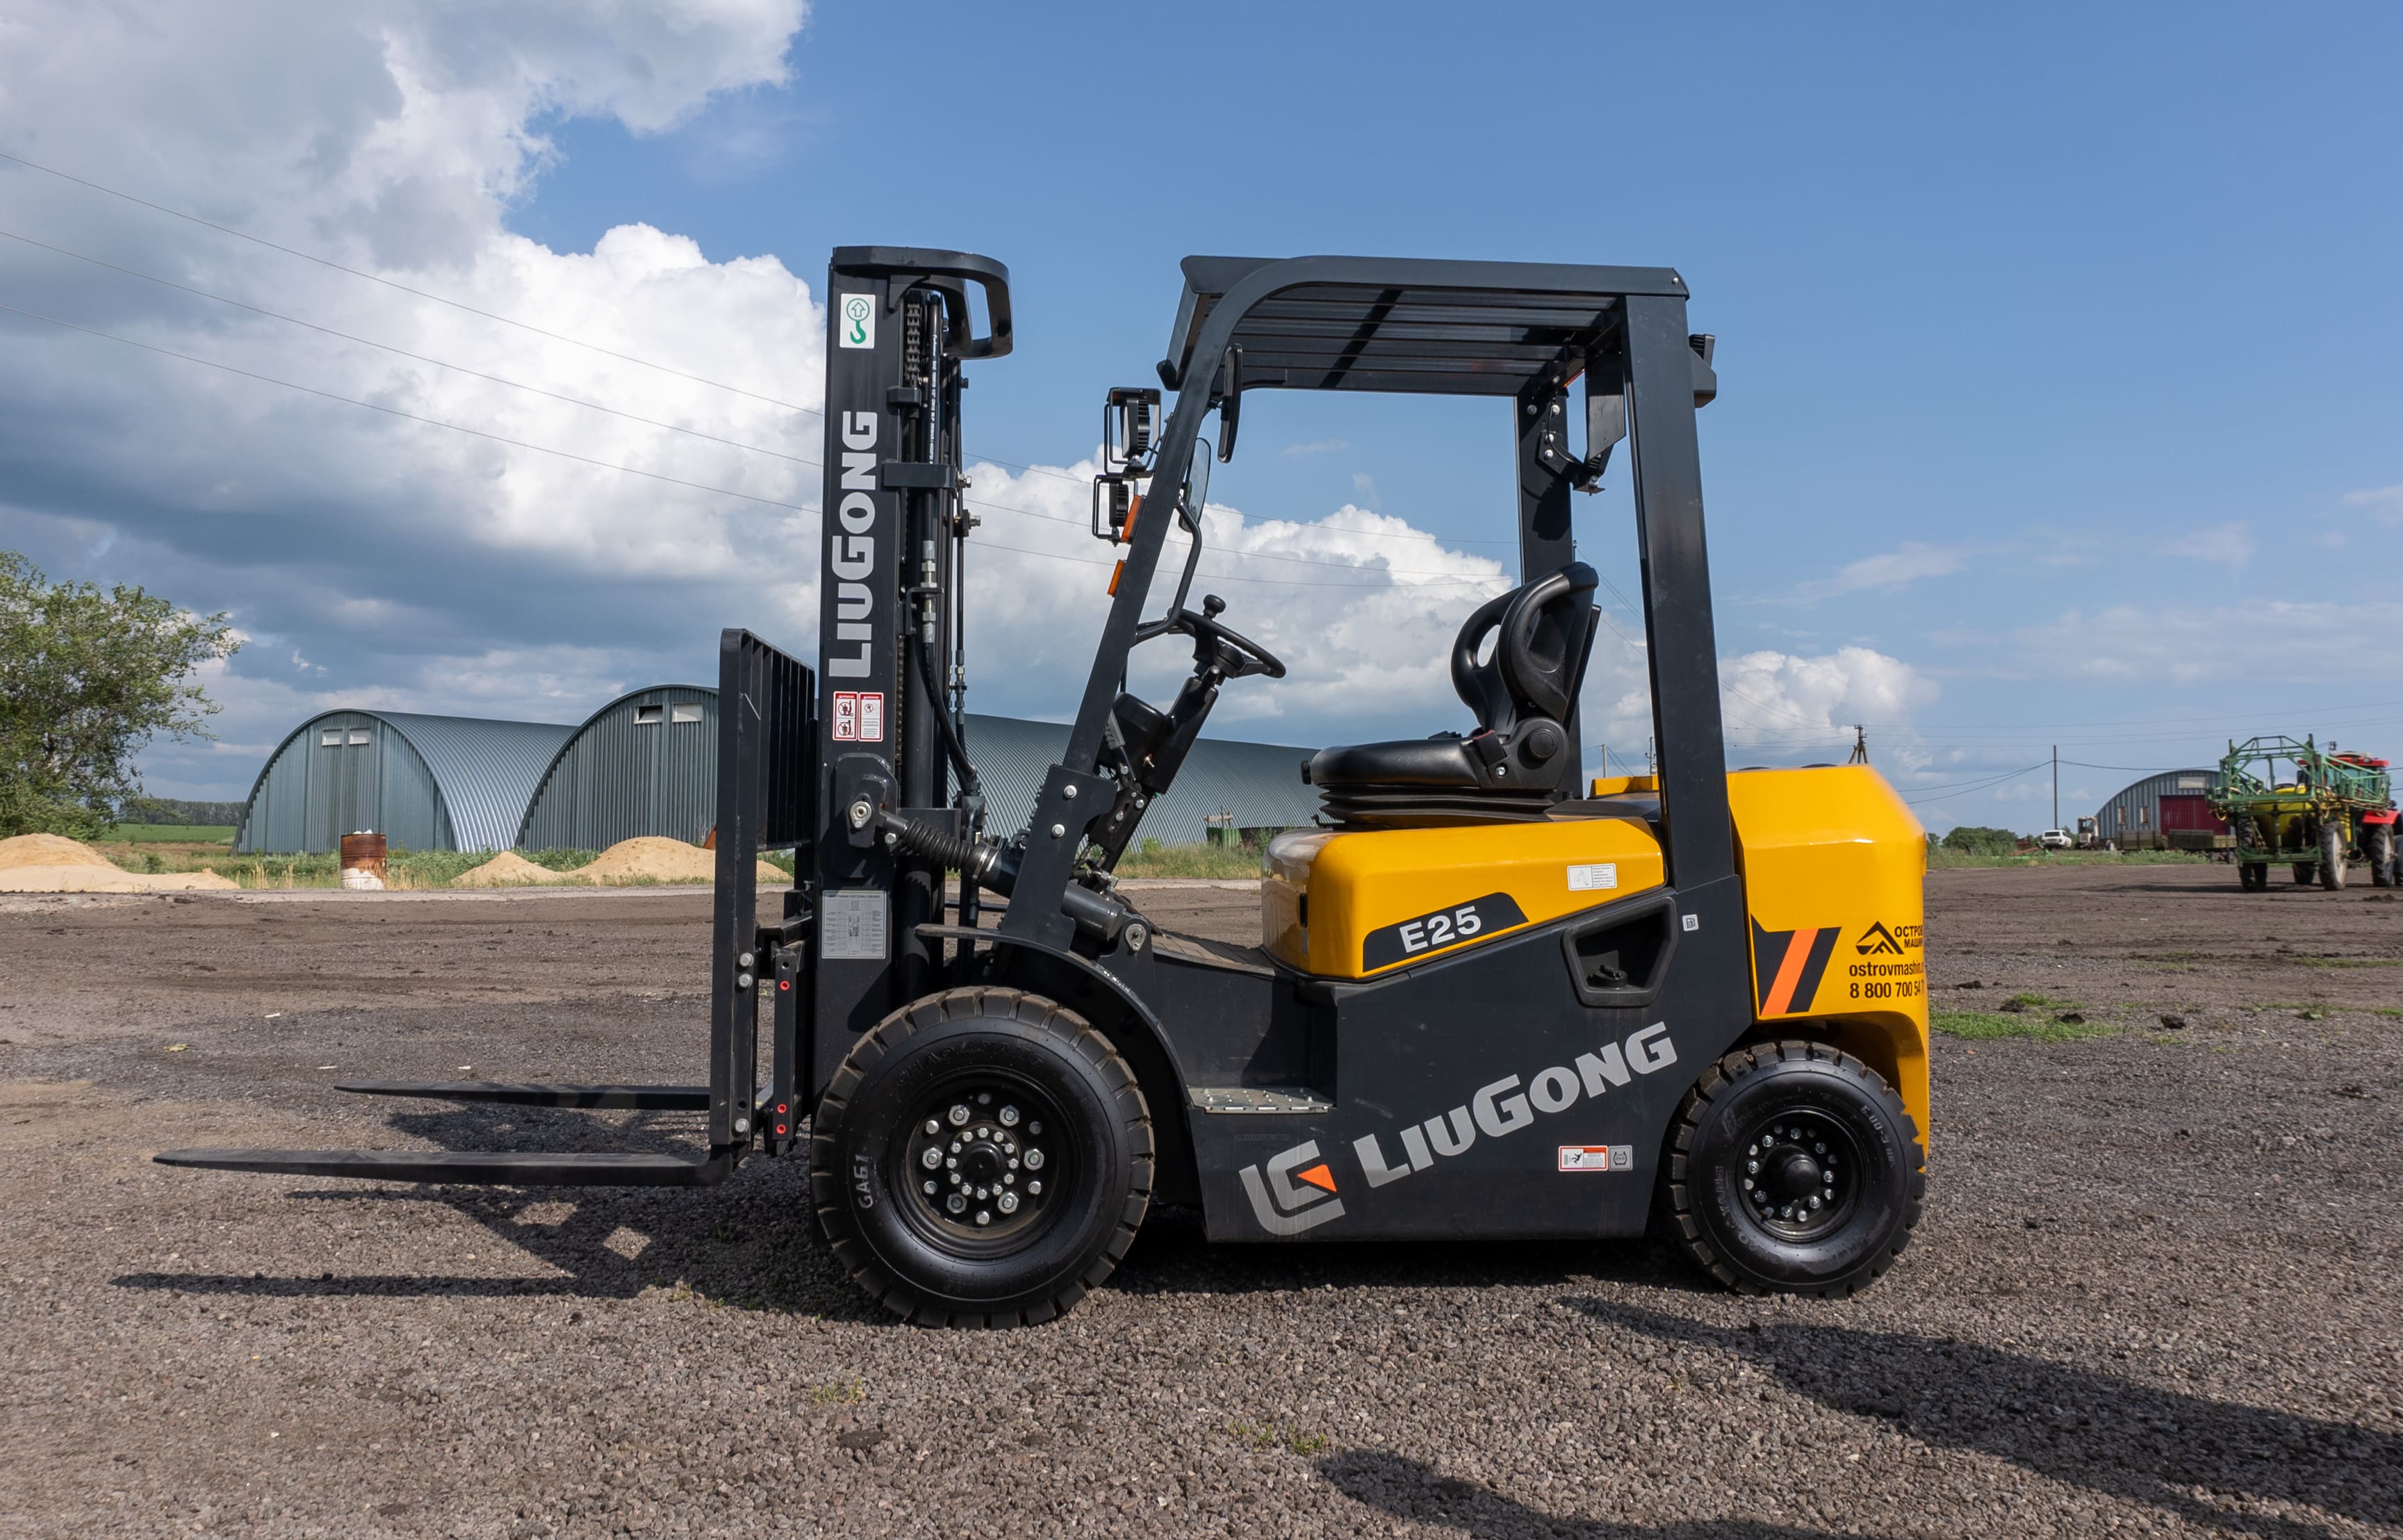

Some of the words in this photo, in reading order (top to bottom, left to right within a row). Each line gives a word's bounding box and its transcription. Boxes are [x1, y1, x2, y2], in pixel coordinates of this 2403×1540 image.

[828, 411, 878, 678] LIUGONG
[1399, 905, 1482, 953] E25
[1850, 982, 1860, 999] 8
[1864, 982, 1892, 998] 800
[1896, 981, 1912, 997] 700
[1914, 981, 1921, 995] 54
[1353, 1022, 1678, 1188] LIUGONG
